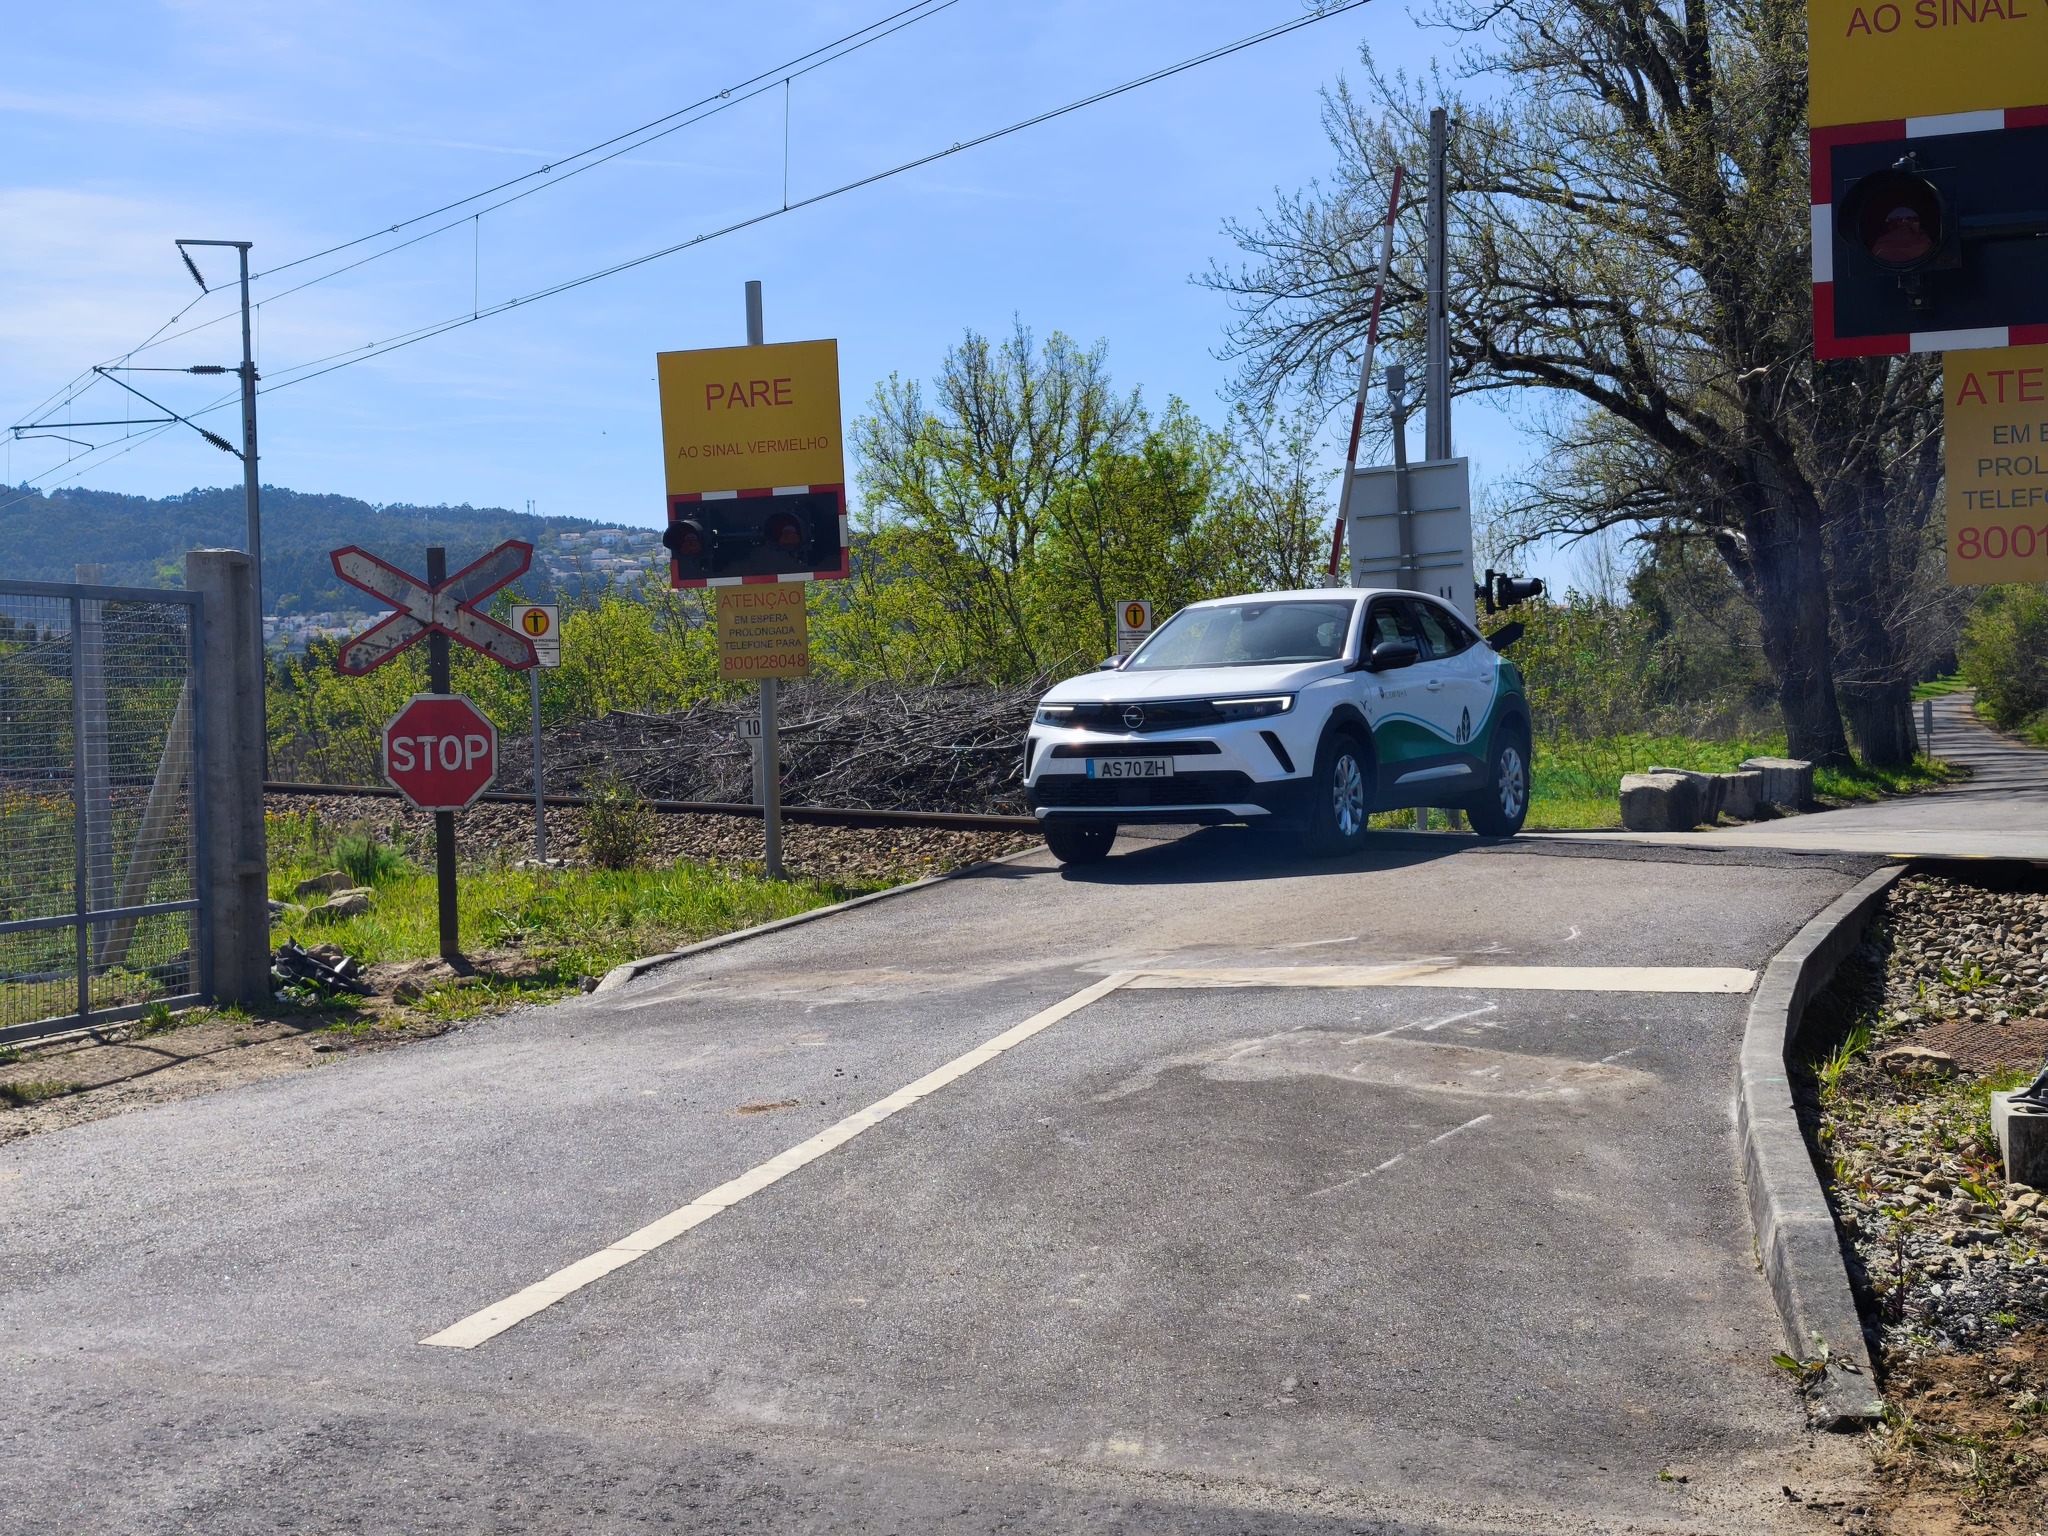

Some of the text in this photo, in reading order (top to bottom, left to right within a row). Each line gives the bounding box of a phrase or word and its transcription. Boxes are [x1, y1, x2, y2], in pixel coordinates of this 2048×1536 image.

[1845, 0, 2028, 38] AO SINAL
[705, 377, 793, 411] PARE
[1993, 423, 2030, 445] EM
[678, 436, 829, 459] AO SINAL VERMELHO
[1962, 487, 2048, 510] TELEF
[721, 588, 801, 610] ATENÇÃO
[734, 613, 789, 625] EM ESPERA
[729, 626, 796, 638] PROLONGADA
[724, 638, 802, 651] TELEFONE PARA
[724, 652, 806, 671] 800128048
[745, 719, 760, 736] 10
[392, 734, 489, 772] STOP
